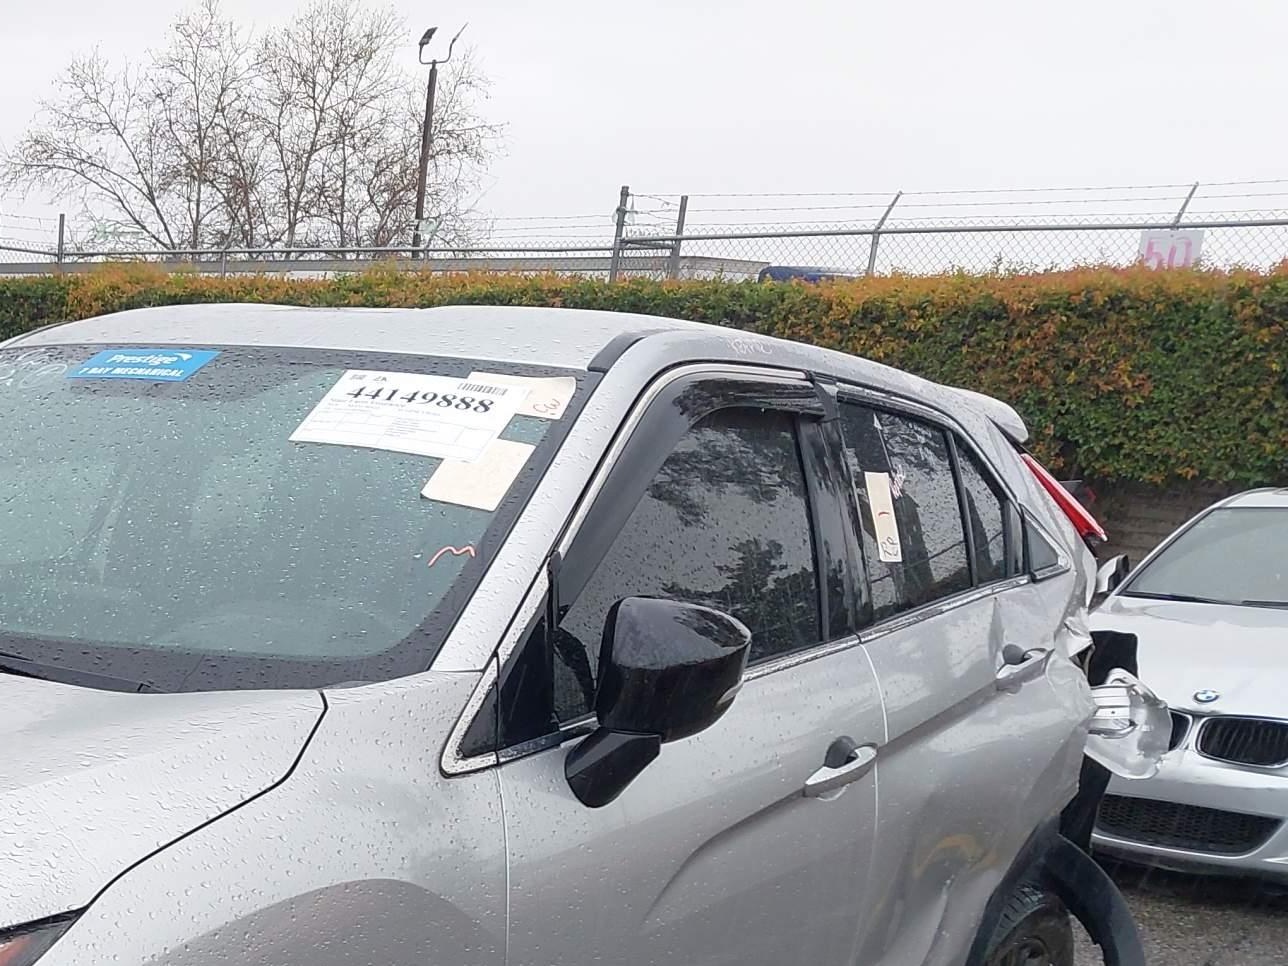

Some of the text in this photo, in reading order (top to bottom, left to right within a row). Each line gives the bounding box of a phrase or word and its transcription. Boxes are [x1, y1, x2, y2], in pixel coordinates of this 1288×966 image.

[106, 352, 179, 366] Prestige
[110, 367, 184, 377] MECHANICAL
[346, 386, 495, 414] 44149888
